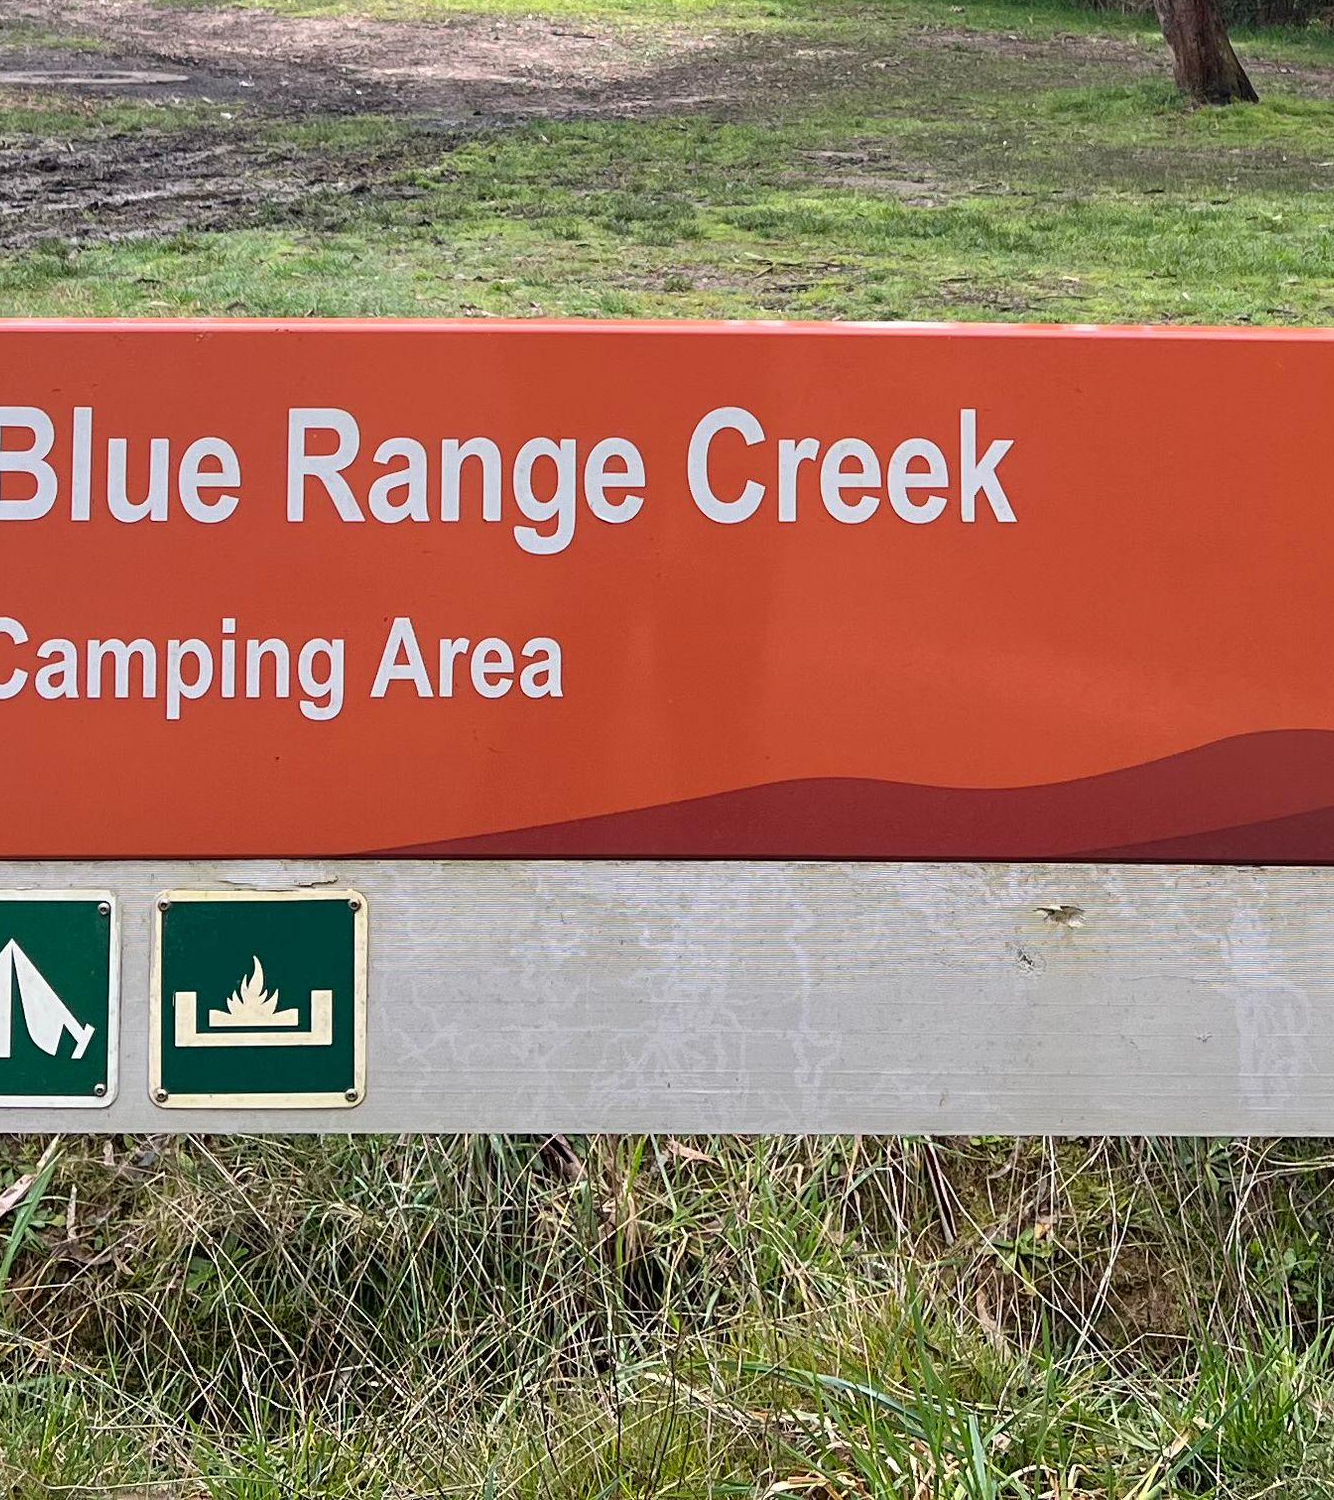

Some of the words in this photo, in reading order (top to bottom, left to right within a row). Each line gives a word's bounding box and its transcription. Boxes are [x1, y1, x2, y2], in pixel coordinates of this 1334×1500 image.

[286, 407, 646, 555] Range
[687, 406, 1018, 524] Creek
[370, 616, 564, 699] Area
